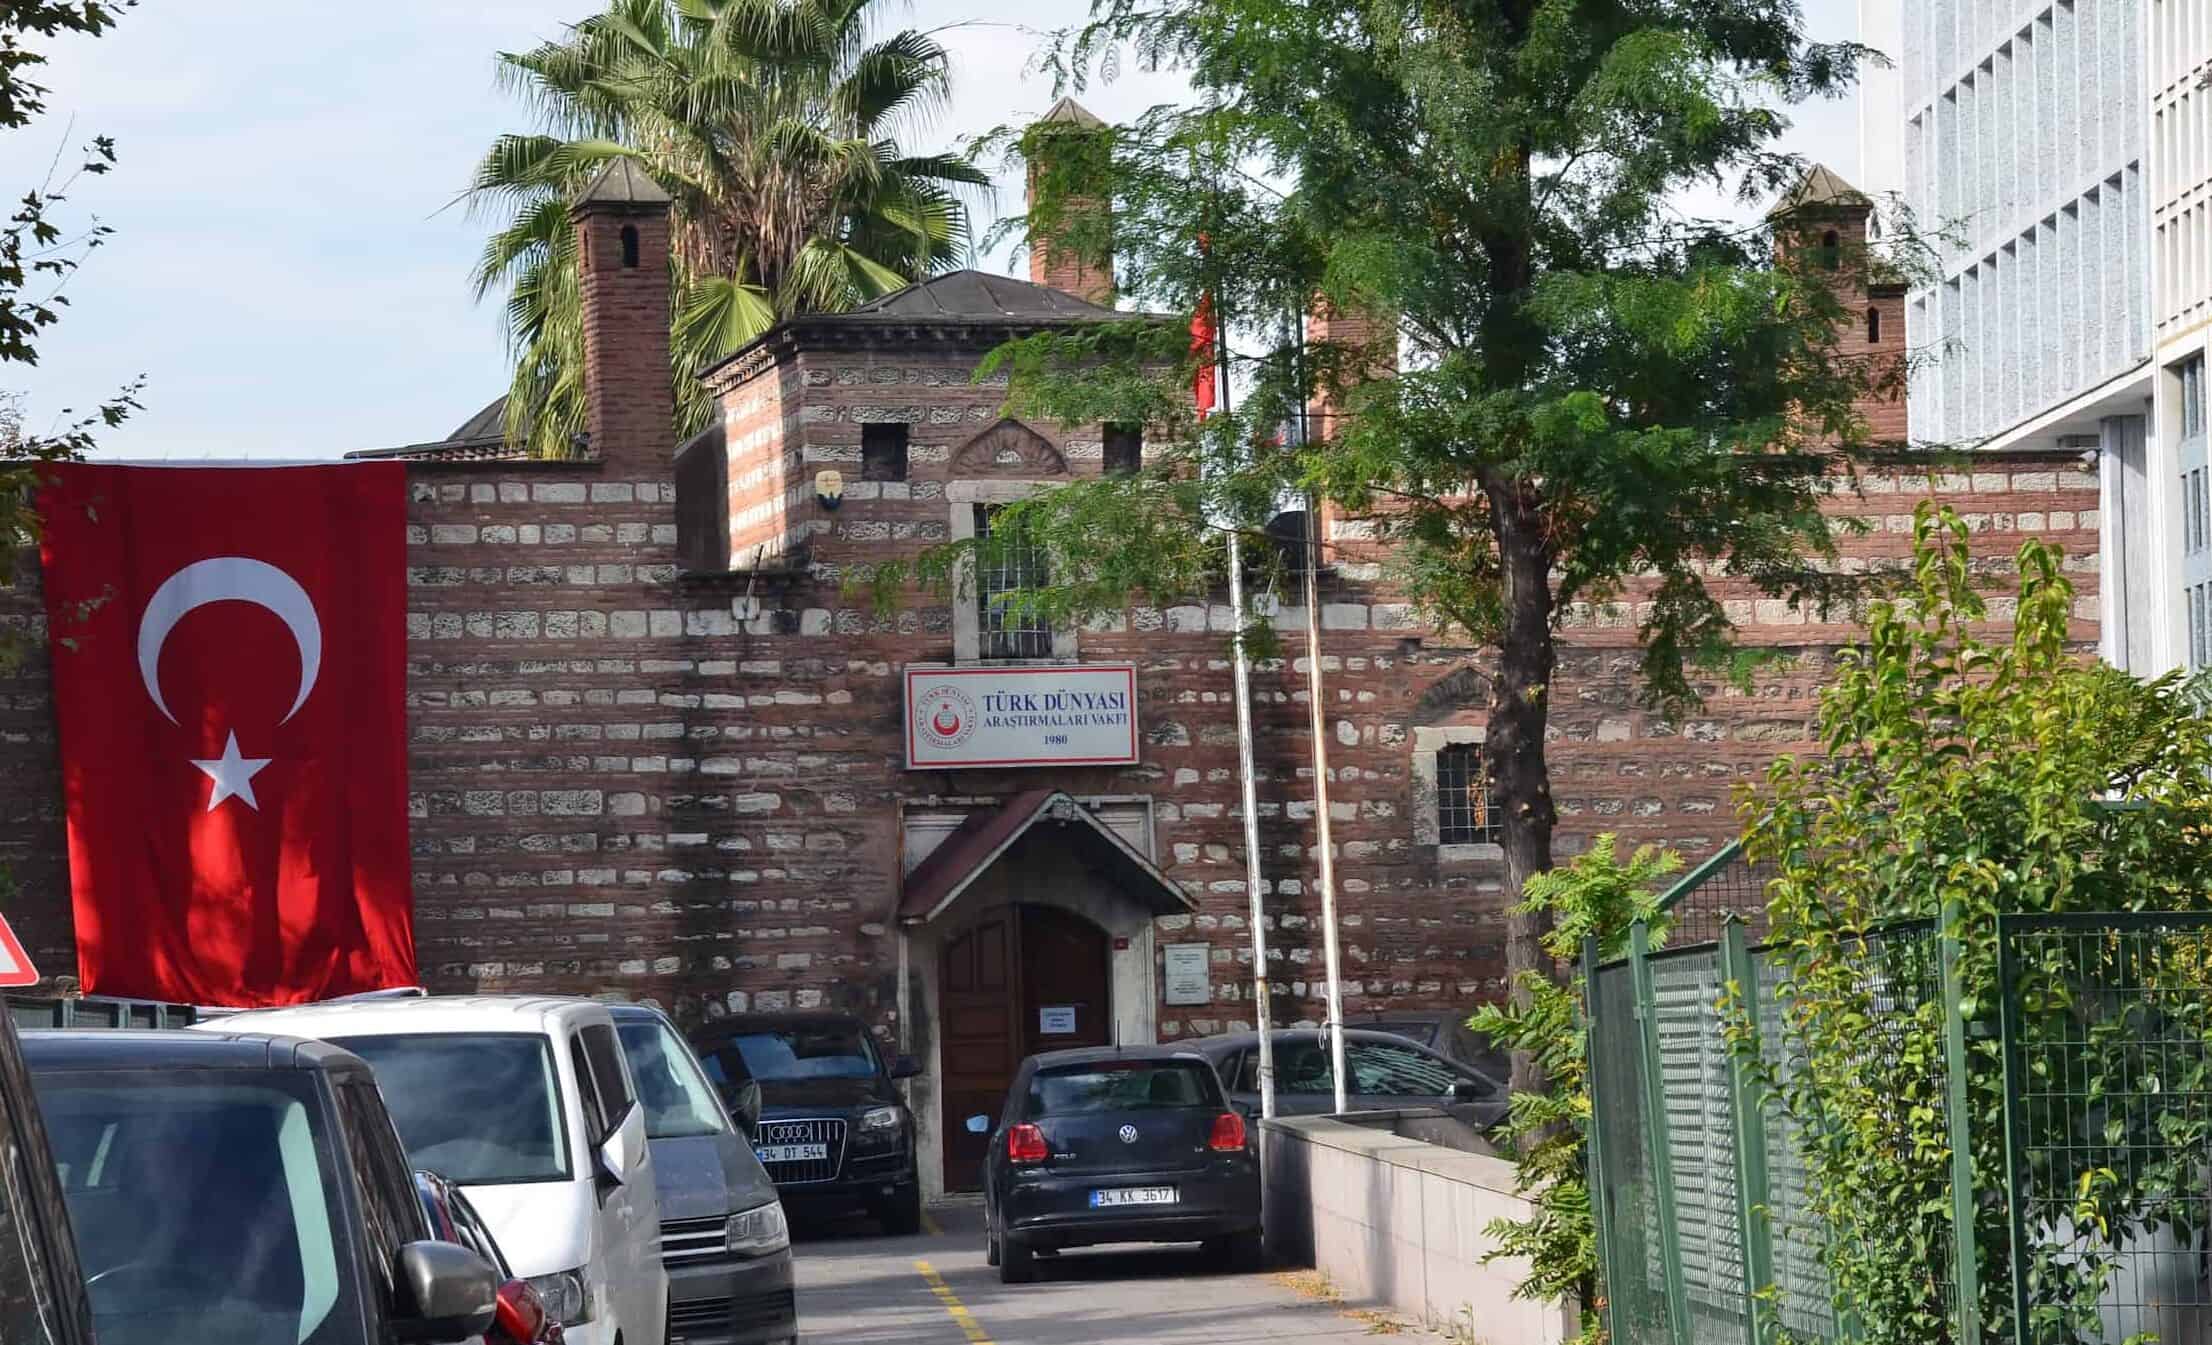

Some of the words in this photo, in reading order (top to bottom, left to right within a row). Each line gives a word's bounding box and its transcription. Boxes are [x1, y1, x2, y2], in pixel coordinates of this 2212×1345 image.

[982, 689, 1038, 712] TÜRK
[1043, 688, 1125, 711] DÜNYASI
[983, 714, 1088, 728] ARAŞTIRMALARI
[1091, 712, 1128, 726] VAKFI
[1044, 735, 1068, 745] 1980
[763, 1148, 776, 1160] 34
[784, 1147, 797, 1159] DT
[803, 1145, 823, 1158] 544
[1098, 1191, 1112, 1204] 34
[1143, 1188, 1169, 1200] 3617
